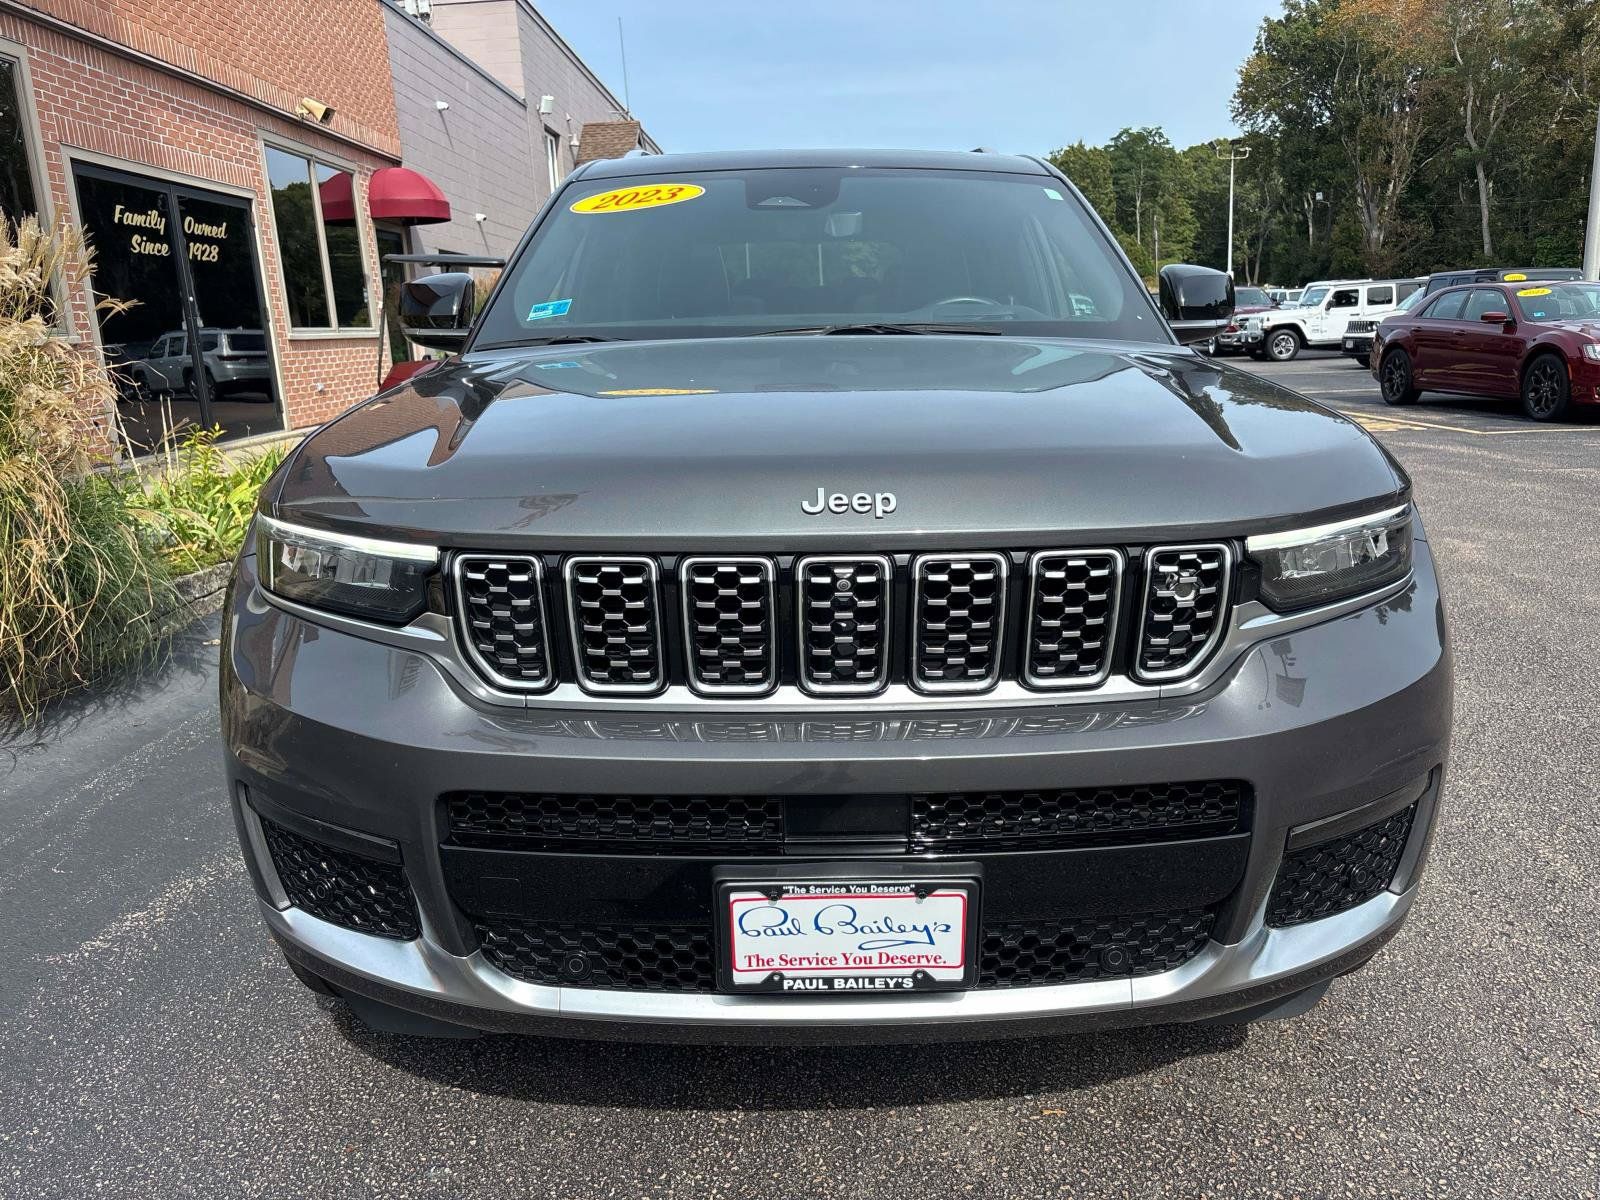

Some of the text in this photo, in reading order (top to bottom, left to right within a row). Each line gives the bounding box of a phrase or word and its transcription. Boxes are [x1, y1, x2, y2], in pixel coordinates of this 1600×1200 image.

[590, 187, 685, 211] 2023
[114, 204, 228, 239] Family Owned
[131, 234, 219, 262] Since 1928
[801, 487, 897, 519] Jeep
[782, 884, 916, 895] "The Service You Deserve"
[738, 903, 952, 951] Paul Bailey's
[744, 951, 947, 968] The Service You Deserve.
[783, 978, 914, 990] PAUL BAILEY'S
